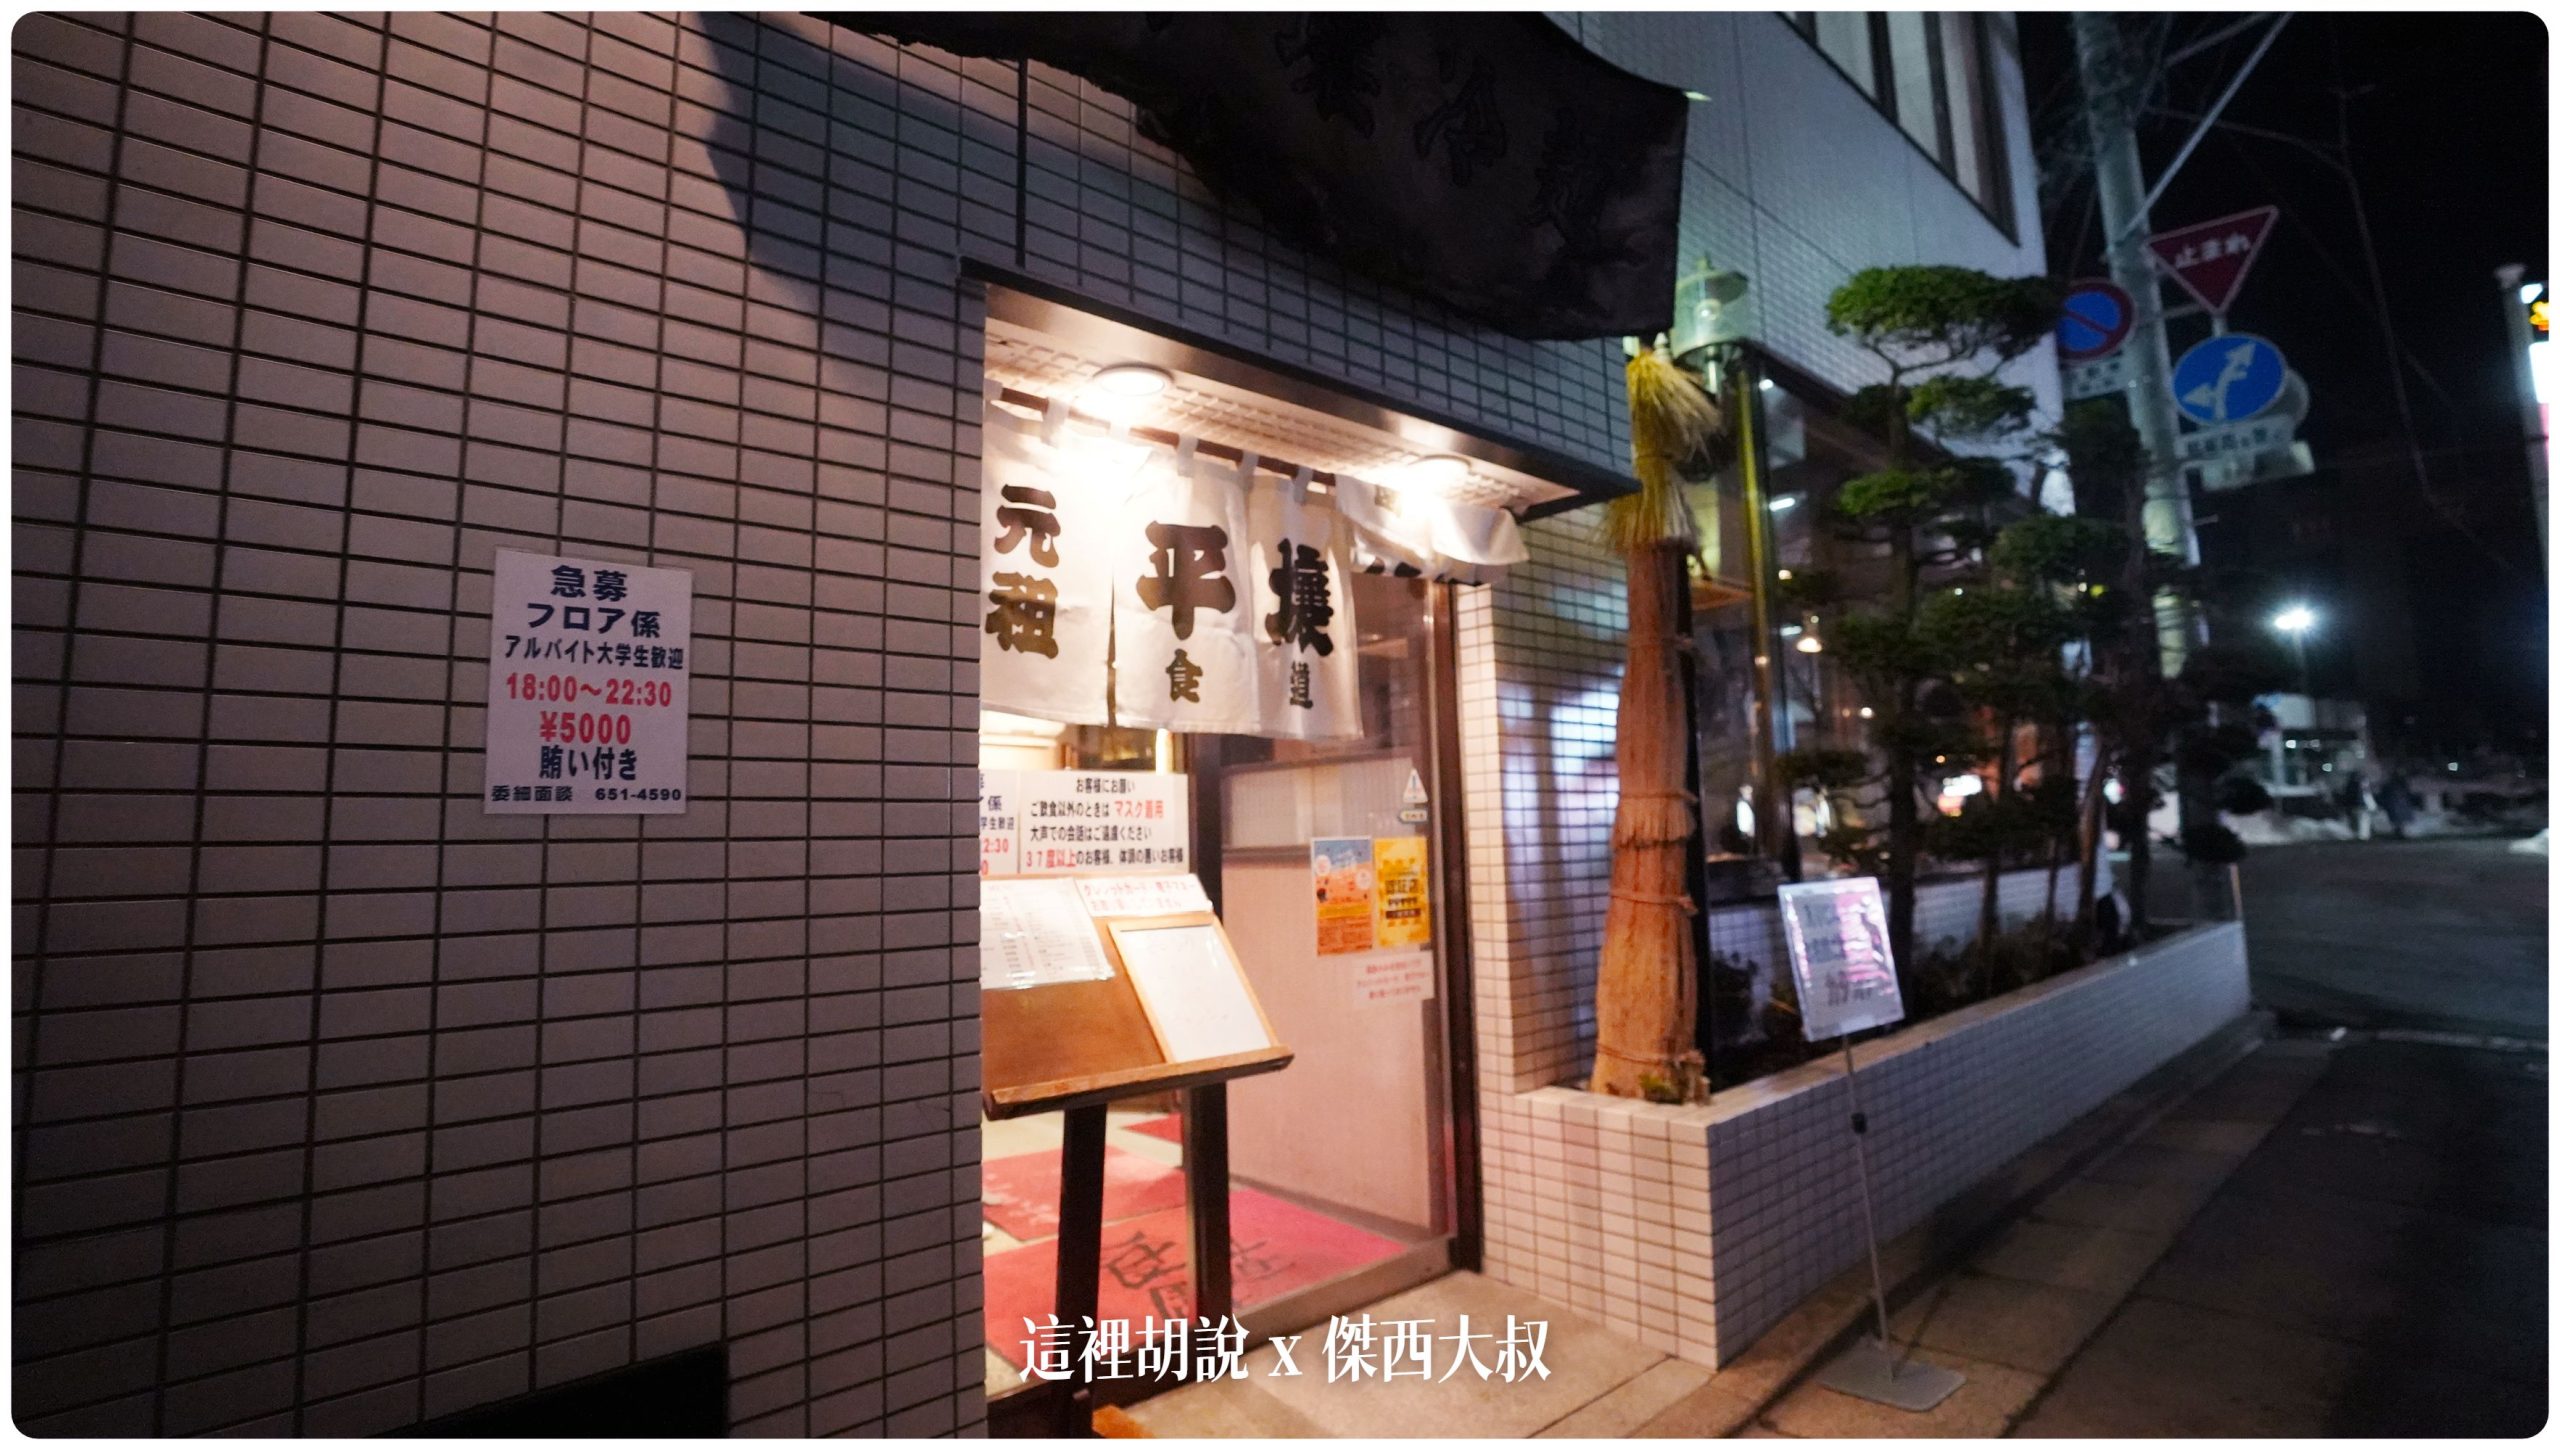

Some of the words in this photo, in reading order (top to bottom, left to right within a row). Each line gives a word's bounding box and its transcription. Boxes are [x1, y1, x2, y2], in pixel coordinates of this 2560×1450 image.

[550, 565, 627, 602] 急募
[985, 484, 1061, 659] 元祖
[527, 603, 660, 638] フロア係
[505, 635, 683, 670] アルバイト大学生歓迎
[539, 710, 631, 744] ¥5000
[539, 745, 637, 780] 賄い付き
[491, 785, 573, 802] 委細面談
[595, 787, 682, 802] 651-4590
[1075, 778, 1136, 794] お客様にお願い
